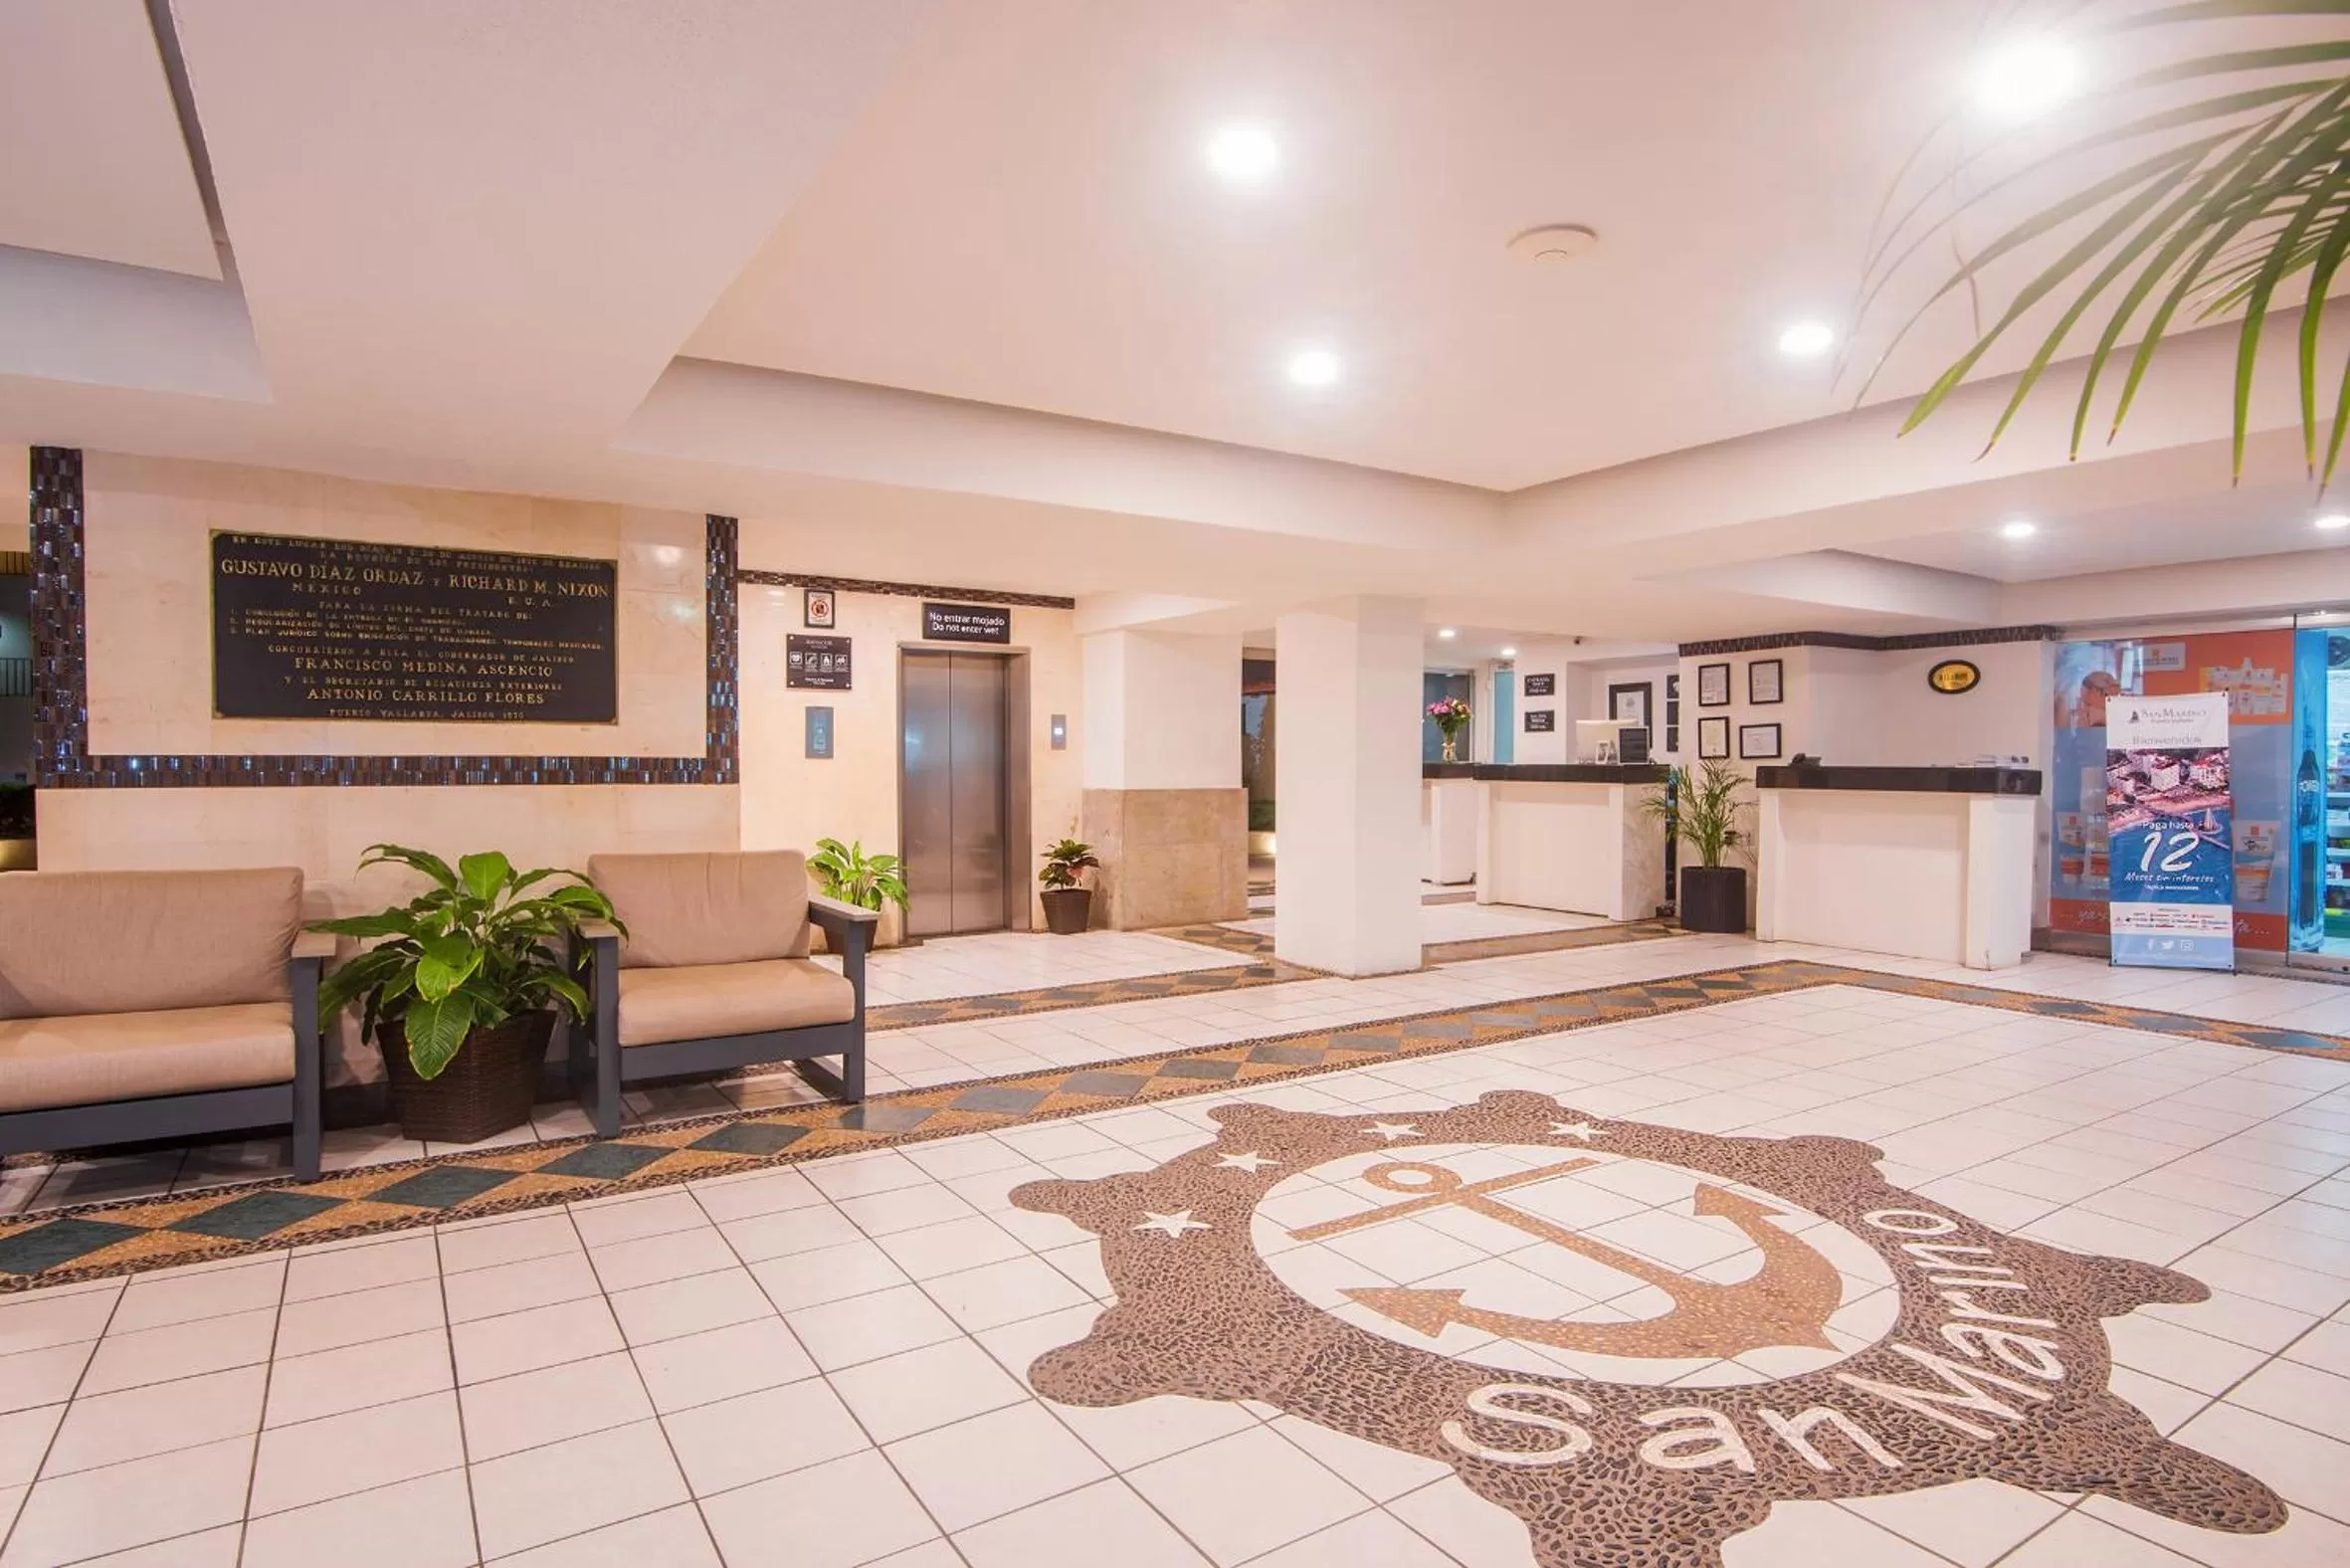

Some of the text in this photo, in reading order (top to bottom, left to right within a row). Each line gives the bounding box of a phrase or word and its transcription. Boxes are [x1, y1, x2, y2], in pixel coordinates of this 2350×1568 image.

[221, 558, 302, 577] GUSTAVO
[363, 568, 424, 586] ORDAZ
[450, 574, 528, 592] RICHARD
[557, 582, 609, 597] NIXON
[929, 612, 1005, 627] No entrar mojado
[932, 622, 999, 635] Do not enter wet
[294, 657, 553, 678] FRANCISCO MEDINA ASCENCIO
[307, 687, 545, 704] ANTONIO CARRILLO FLORES
[2142, 821, 2194, 831] Paga hasta
[2140, 831, 2200, 872] 12
[2124, 872, 2153, 882] Meses
[1440, 1208, 2066, 1473] San Marino
